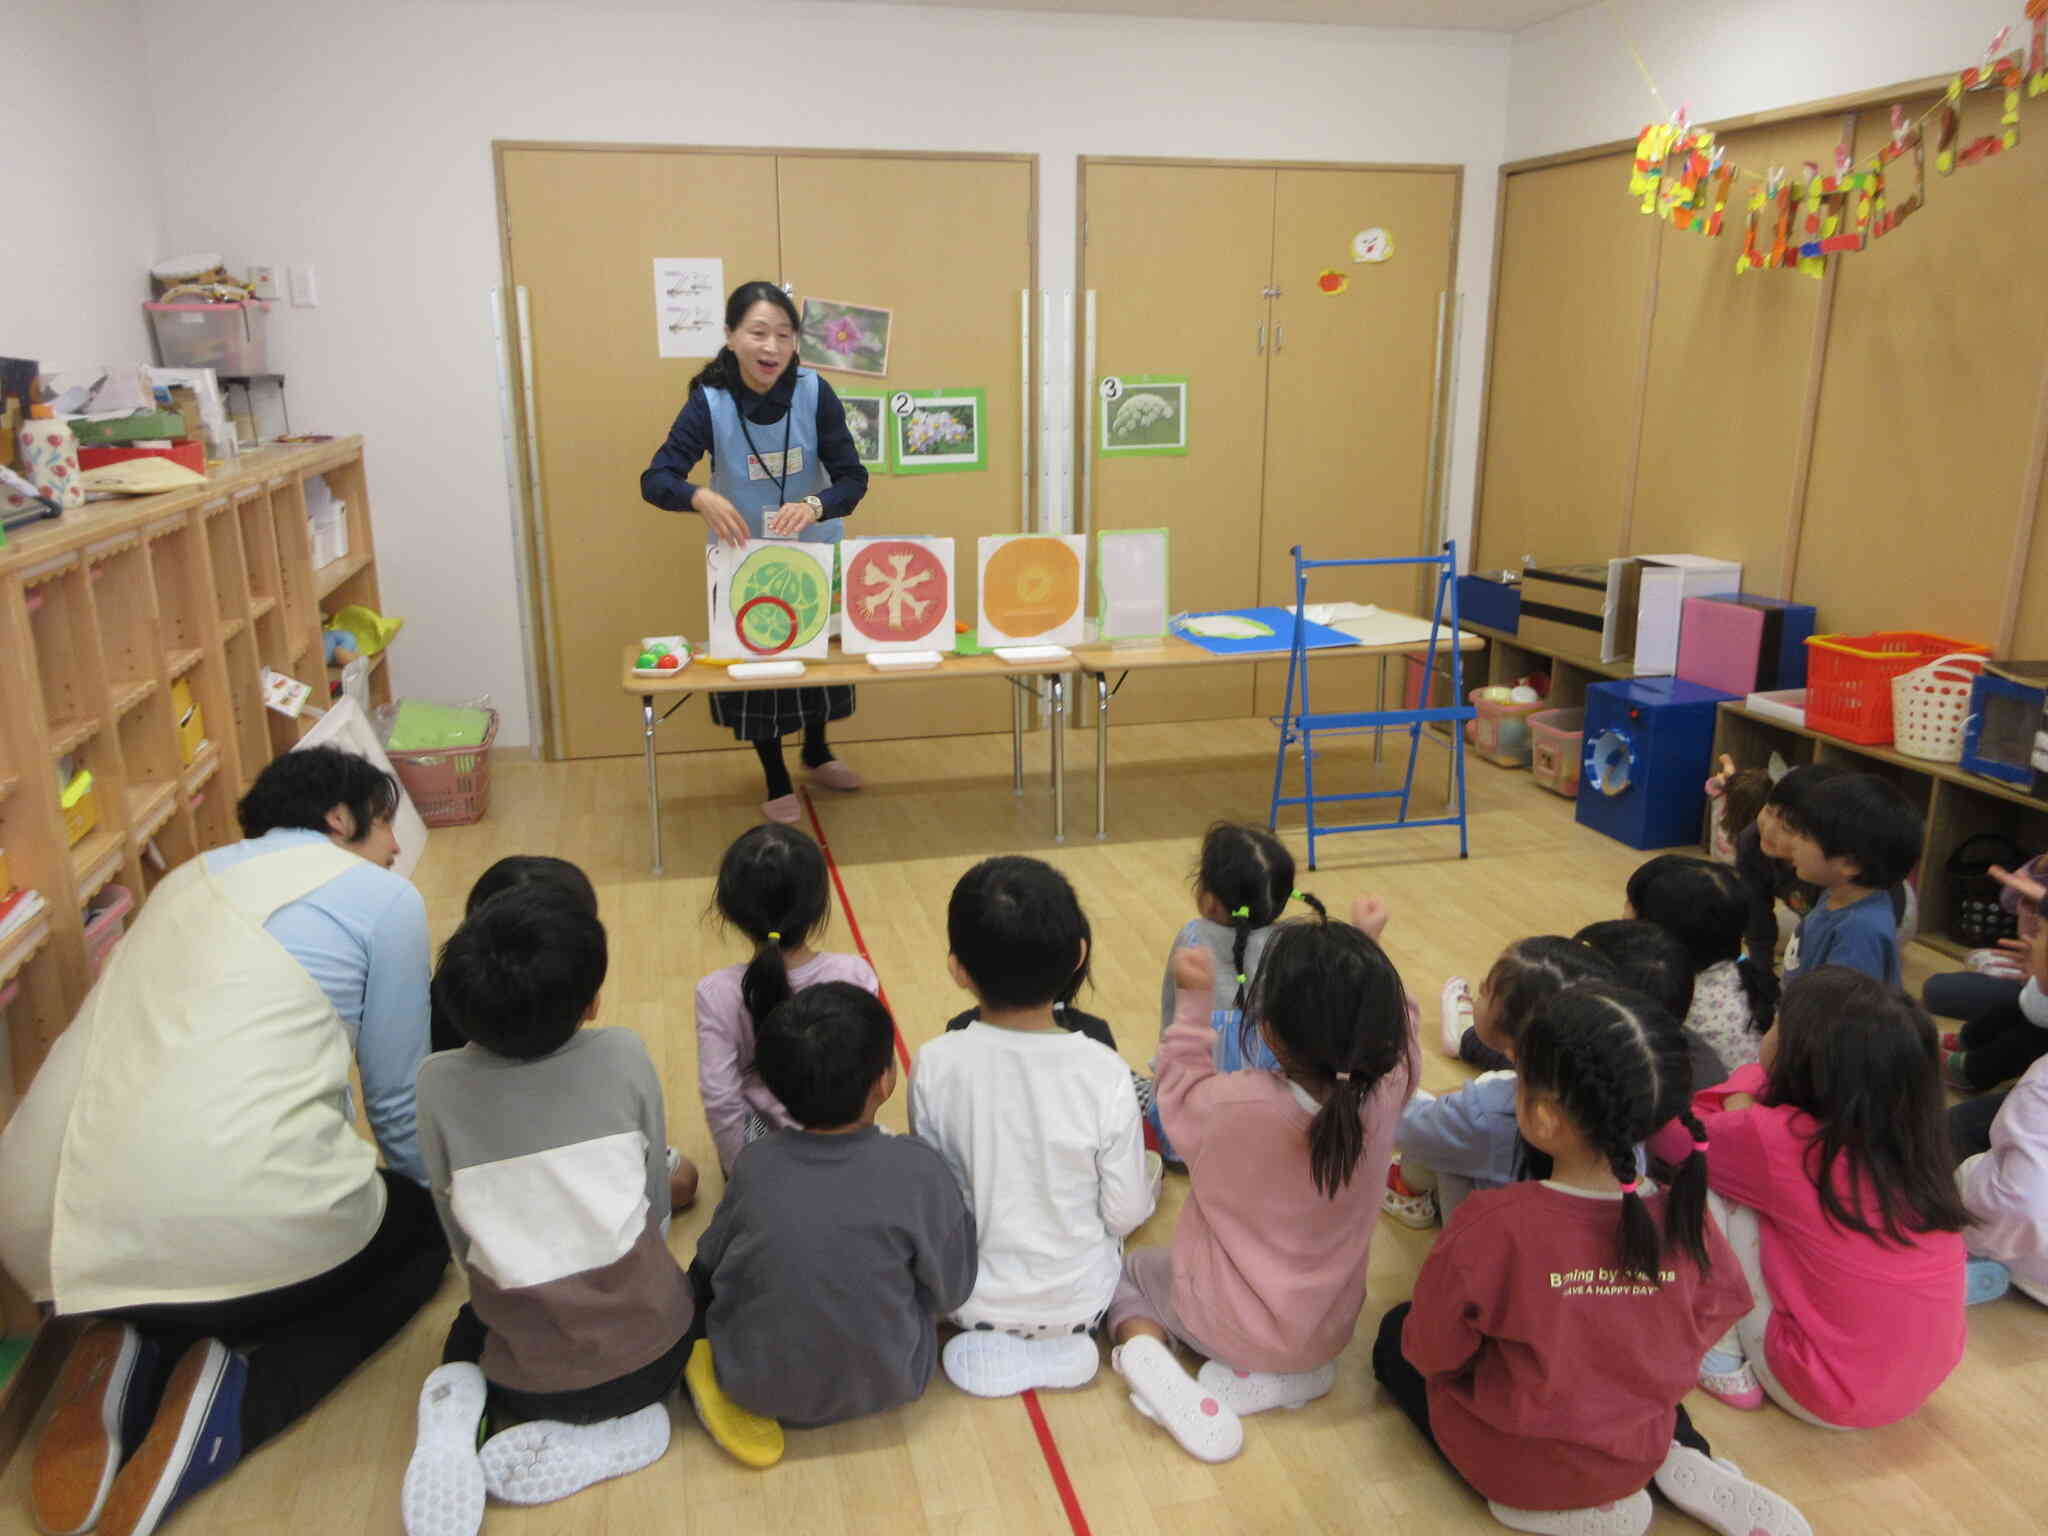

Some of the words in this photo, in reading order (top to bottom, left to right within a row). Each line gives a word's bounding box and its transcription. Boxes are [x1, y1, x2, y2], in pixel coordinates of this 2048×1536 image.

[1104, 378, 1117, 398] 3
[896, 394, 909, 413] 2
[1599, 1267, 1617, 1284] by
[1585, 1286, 1593, 1295] A
[1595, 1285, 1630, 1296] HAPPY
